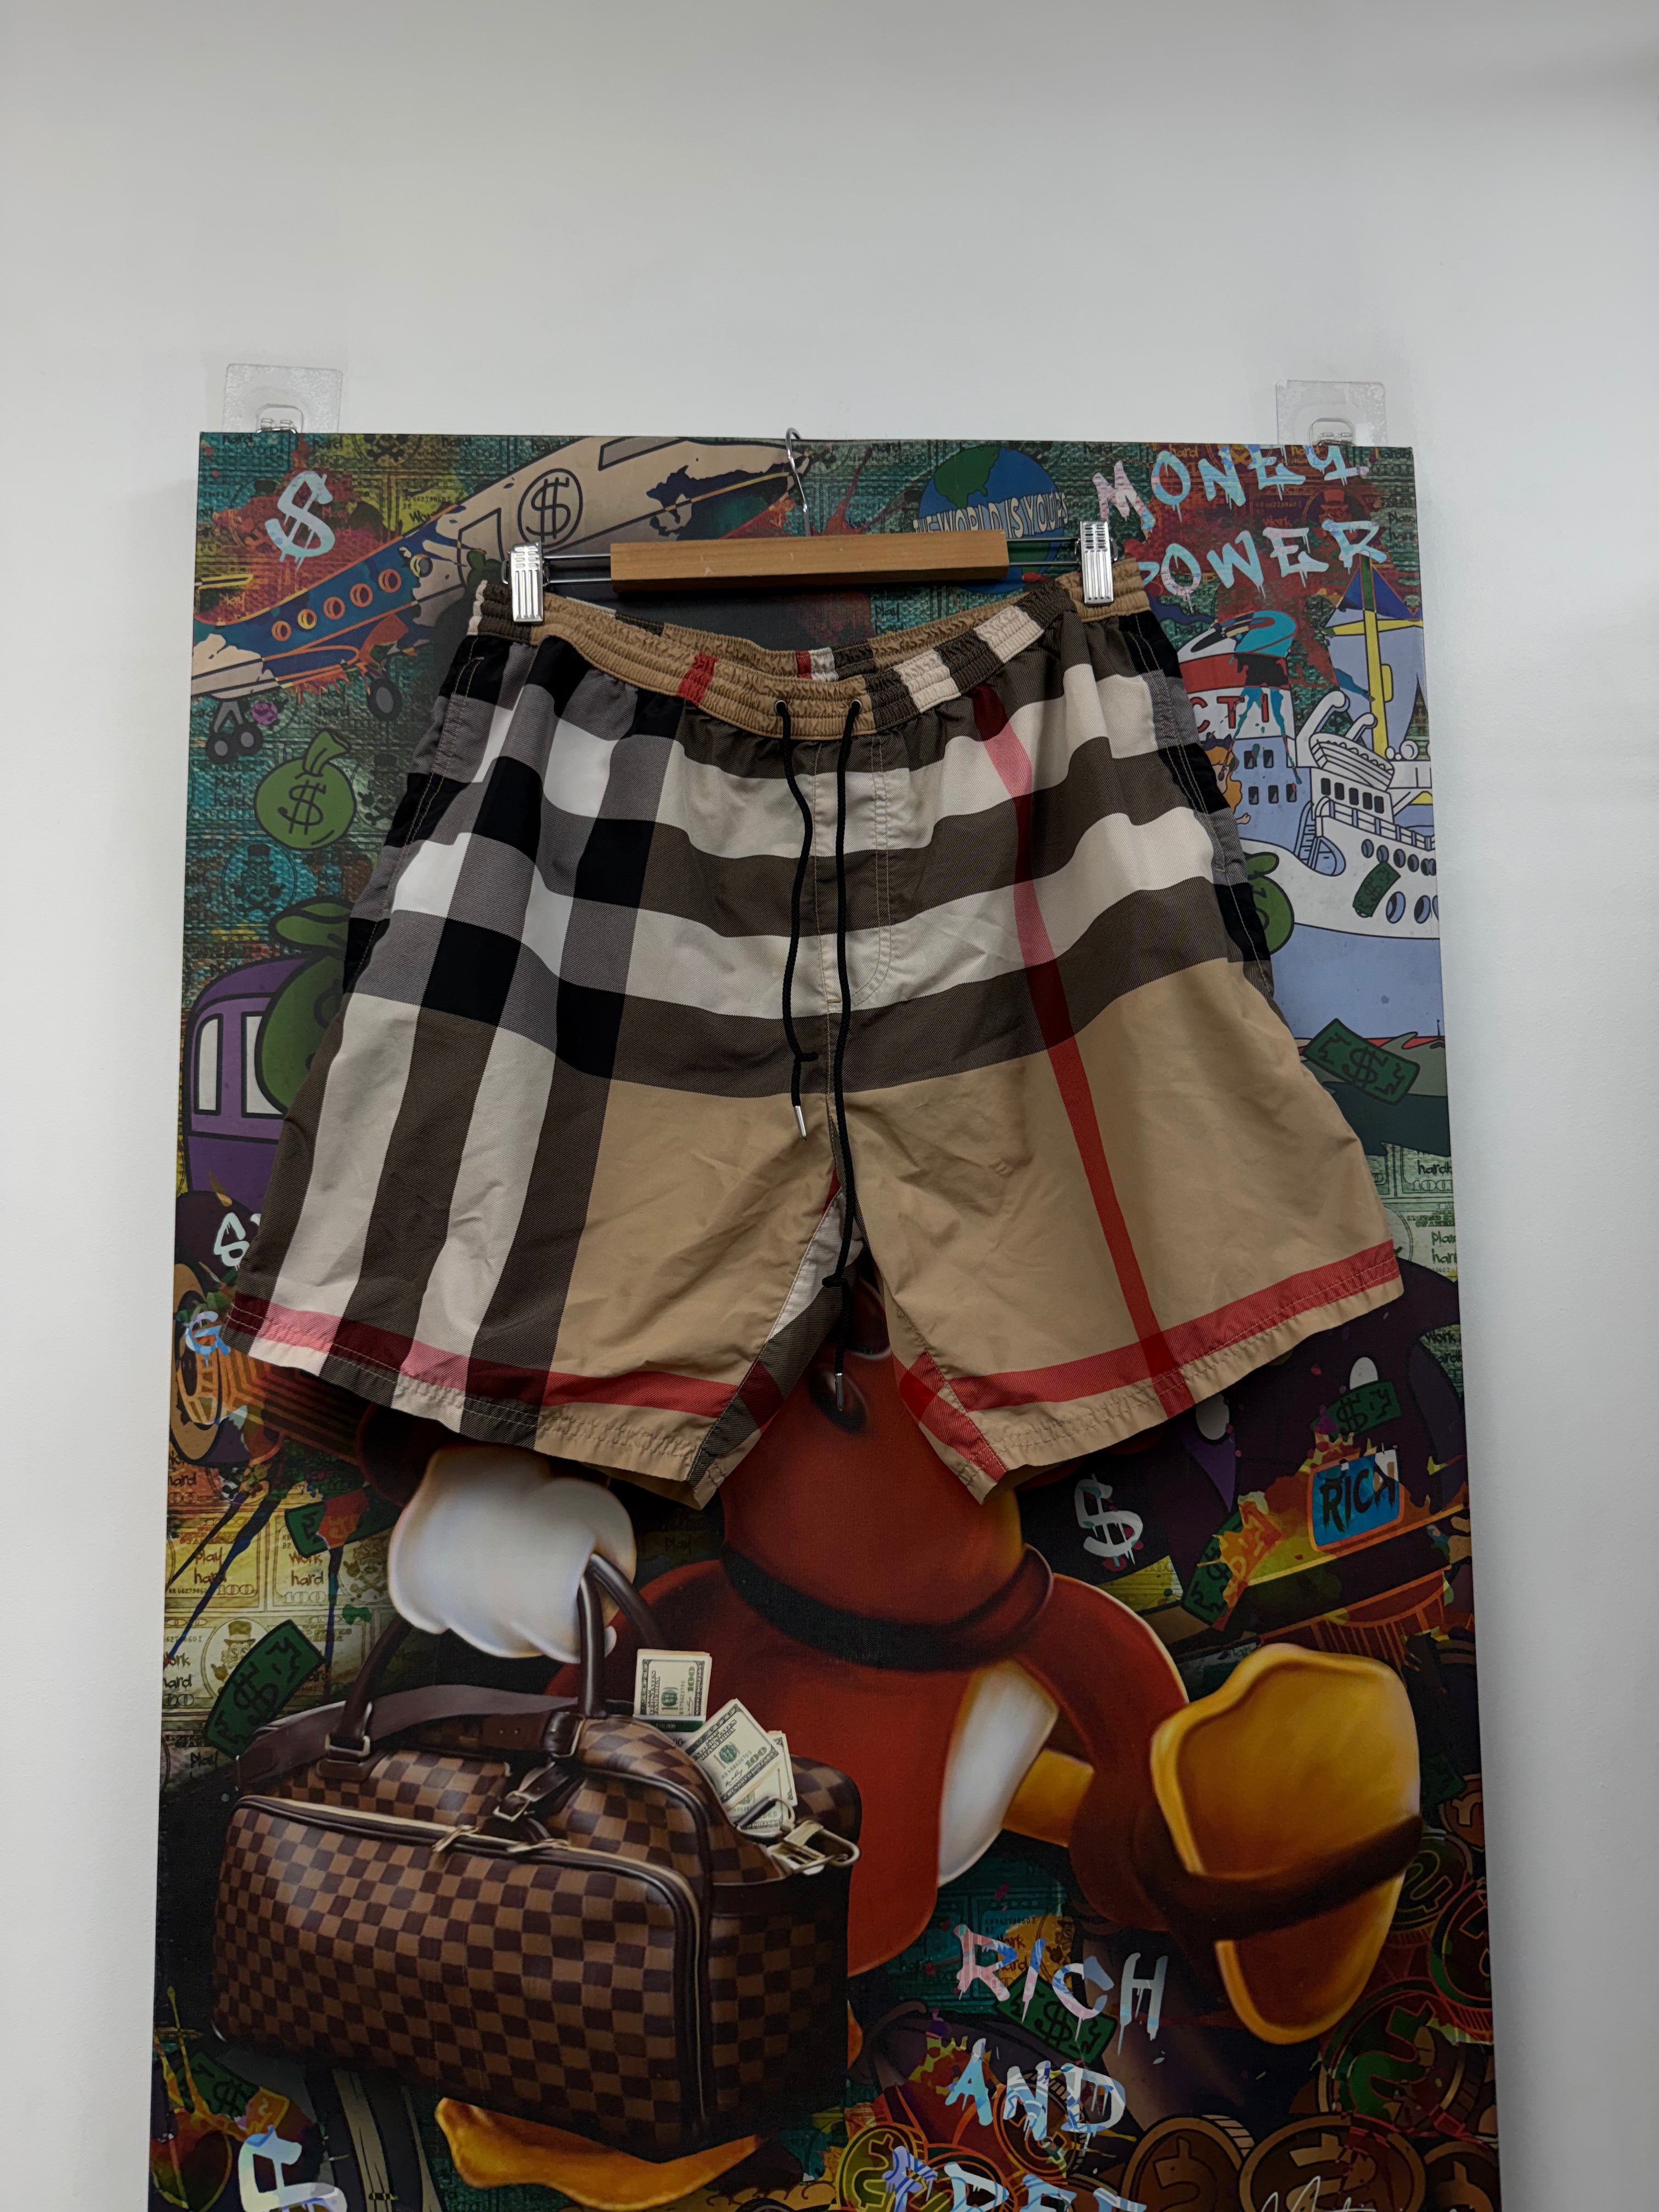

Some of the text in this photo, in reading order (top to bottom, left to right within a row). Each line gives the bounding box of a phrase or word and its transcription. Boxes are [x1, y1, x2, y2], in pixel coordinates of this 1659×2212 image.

[1169, 444, 1199, 459] hard
[1023, 492, 1069, 535] YOURS
[1092, 444, 1370, 543] MONEY
[291, 1570, 324, 1587] hard
[953, 1923, 1169, 2056] RICH
[945, 2038, 1126, 2154] AND
